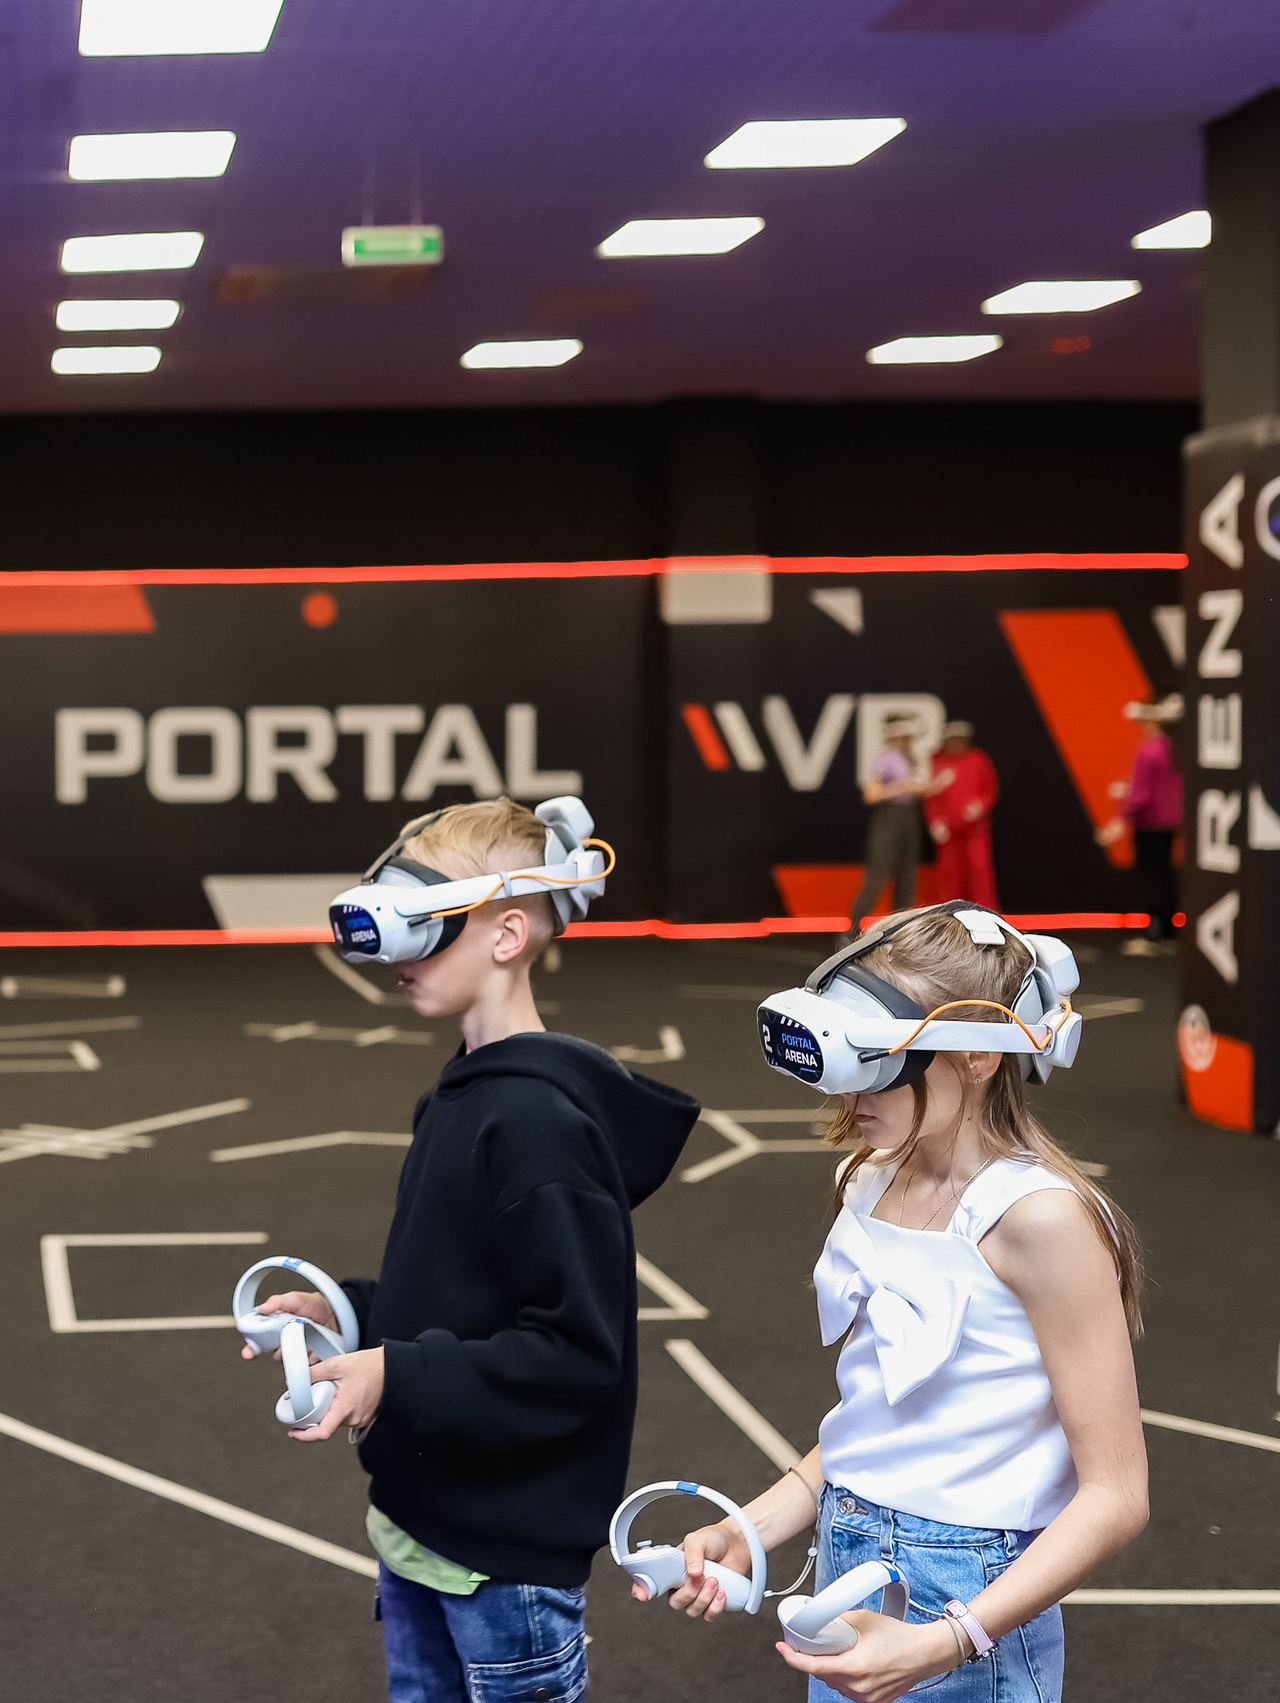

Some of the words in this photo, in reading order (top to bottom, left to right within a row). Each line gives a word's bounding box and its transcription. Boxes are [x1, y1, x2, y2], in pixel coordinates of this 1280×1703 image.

[1196, 473, 1246, 986] ARENA
[55, 703, 584, 805] PORTAL
[762, 692, 947, 791] VR
[762, 1023, 773, 1054] 2
[781, 1033, 815, 1051] PORTAL
[785, 1048, 818, 1067] ARENA
